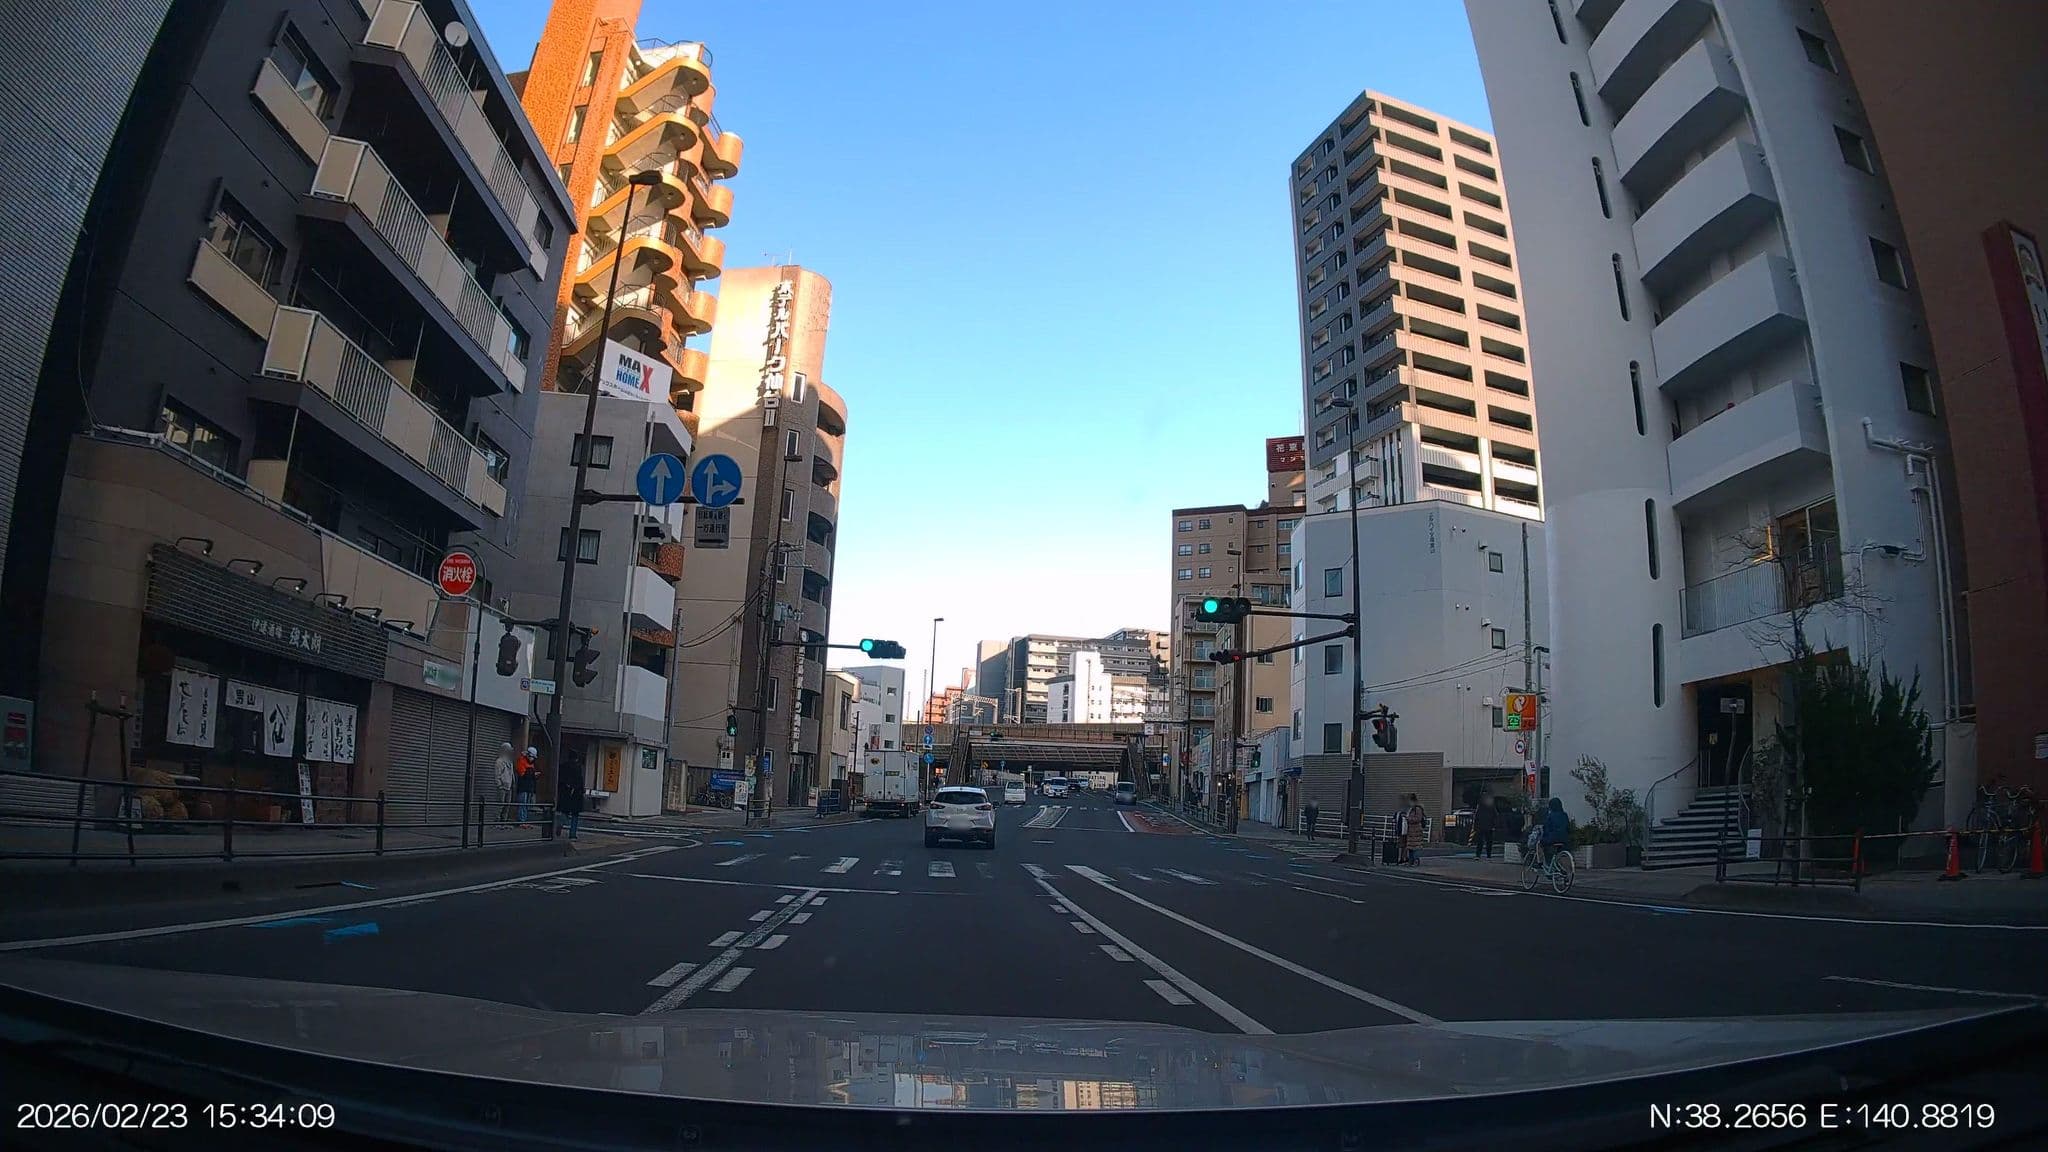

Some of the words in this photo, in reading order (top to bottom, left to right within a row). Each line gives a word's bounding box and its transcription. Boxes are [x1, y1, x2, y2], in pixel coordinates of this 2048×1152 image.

[616, 370, 640, 389] HOME
[618, 353, 653, 394] MAX
[442, 566, 473, 583] 消火栓
[235, 688, 256, 706] 男山
